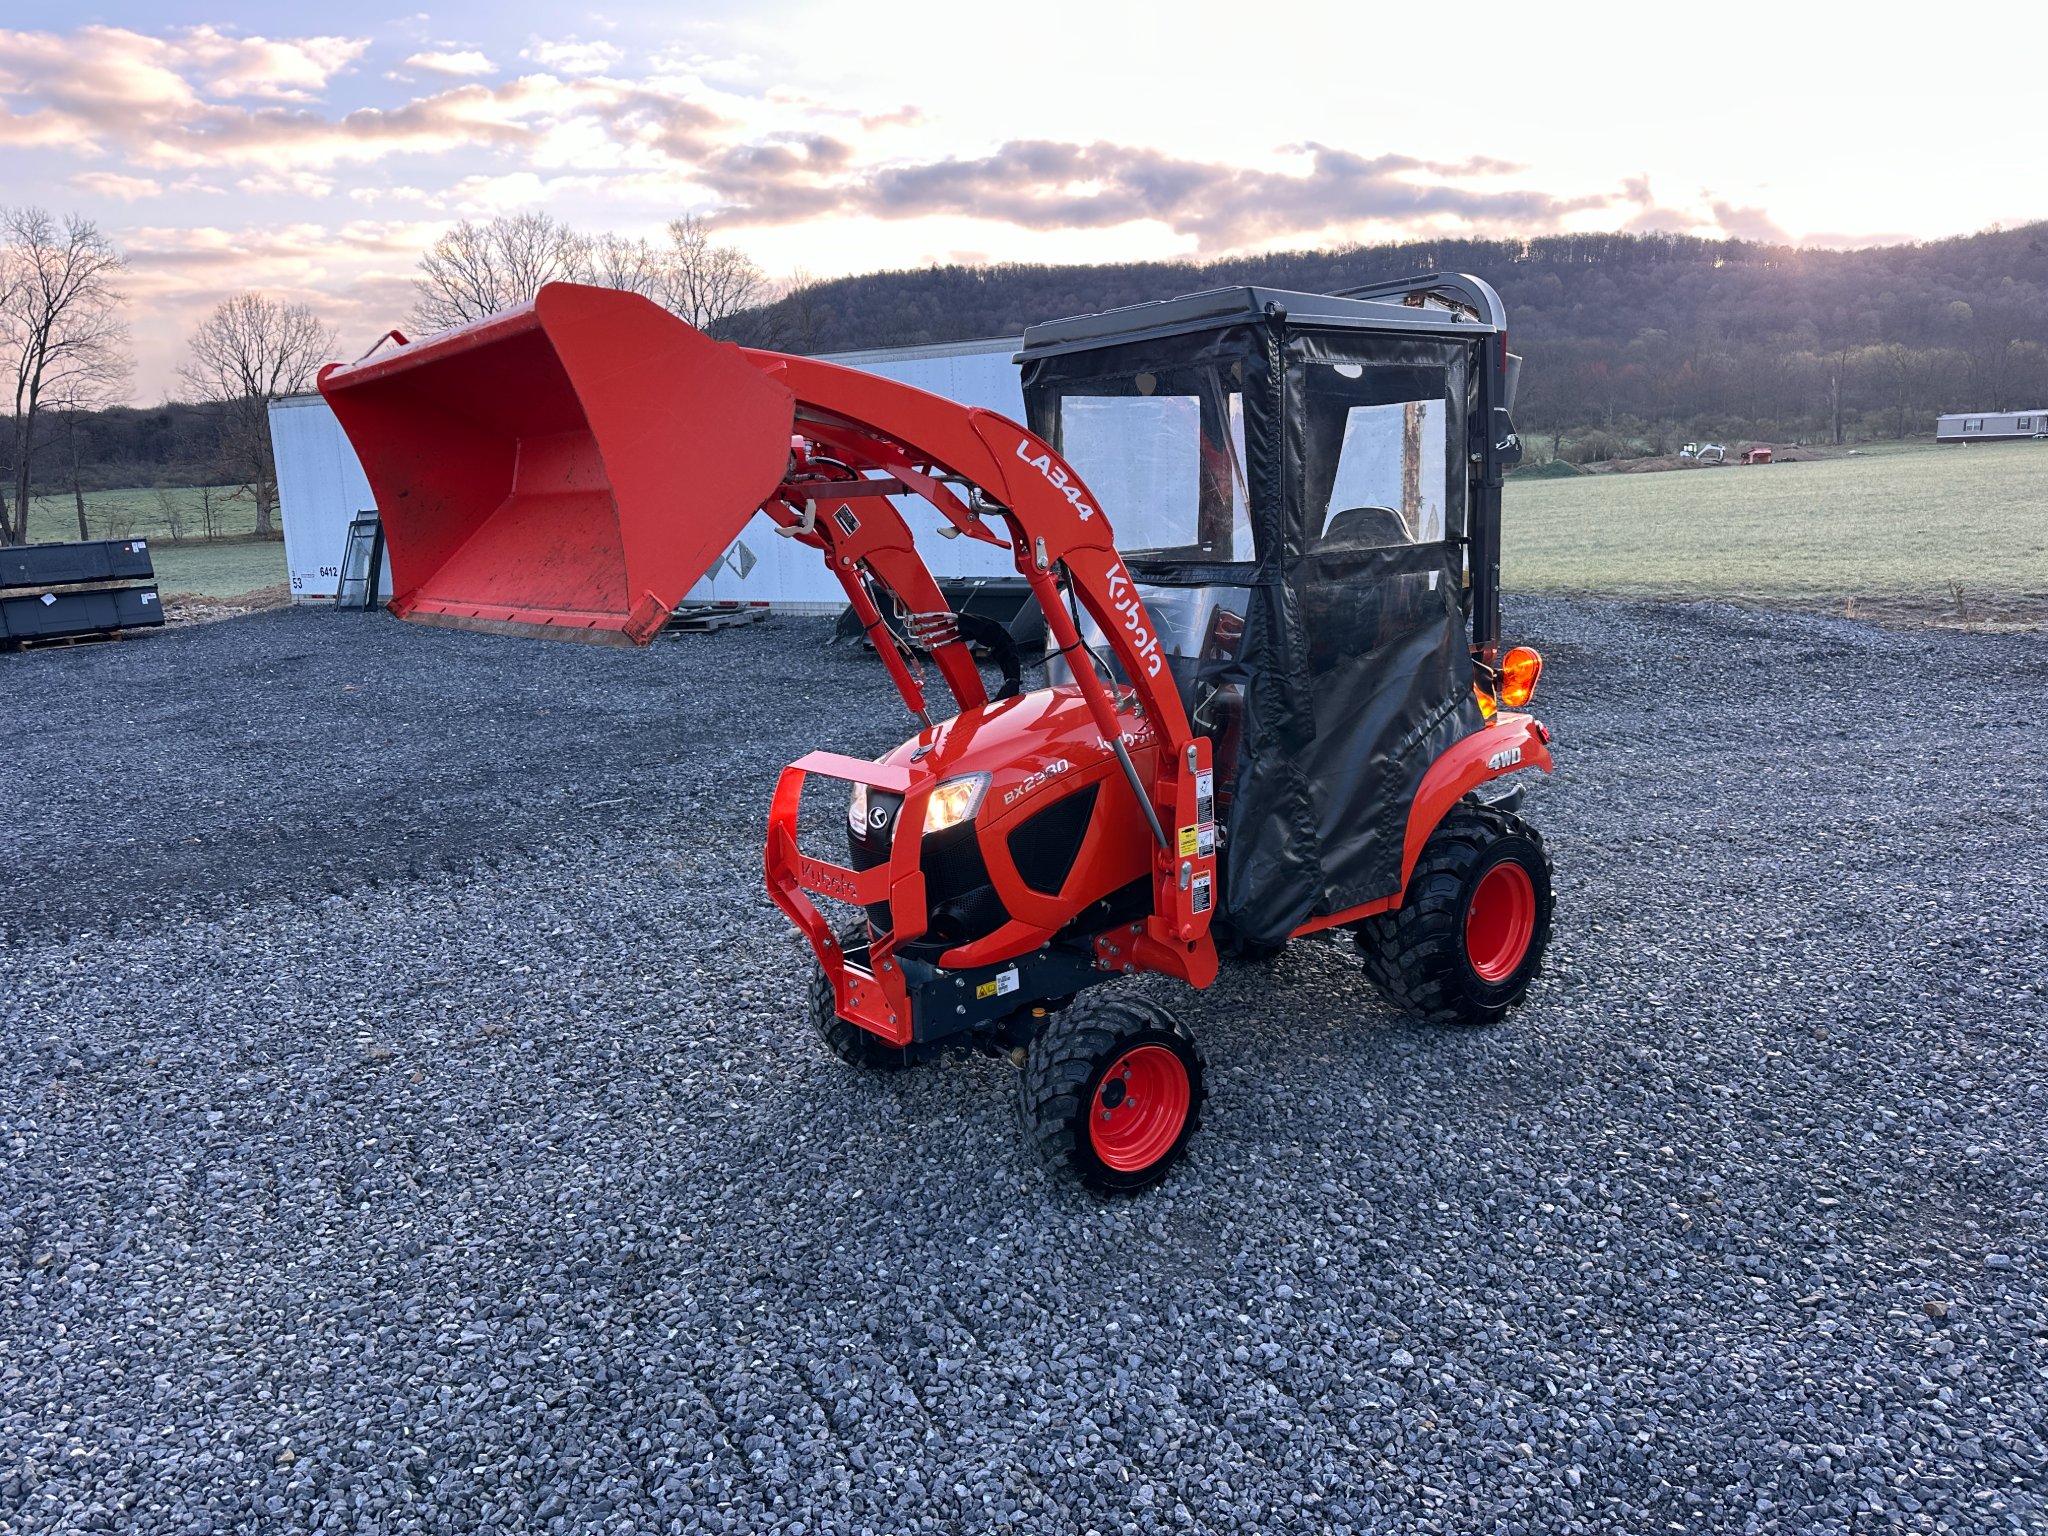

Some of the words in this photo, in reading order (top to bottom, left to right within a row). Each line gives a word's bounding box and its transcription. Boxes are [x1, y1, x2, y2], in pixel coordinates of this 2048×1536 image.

[1015, 438, 1095, 522] LA344
[292, 577, 303, 589] 53
[319, 566, 338, 577] 6412
[1105, 562, 1162, 678] Kubota
[1487, 747, 1522, 770] 4WD
[801, 860, 859, 899] Kubota
